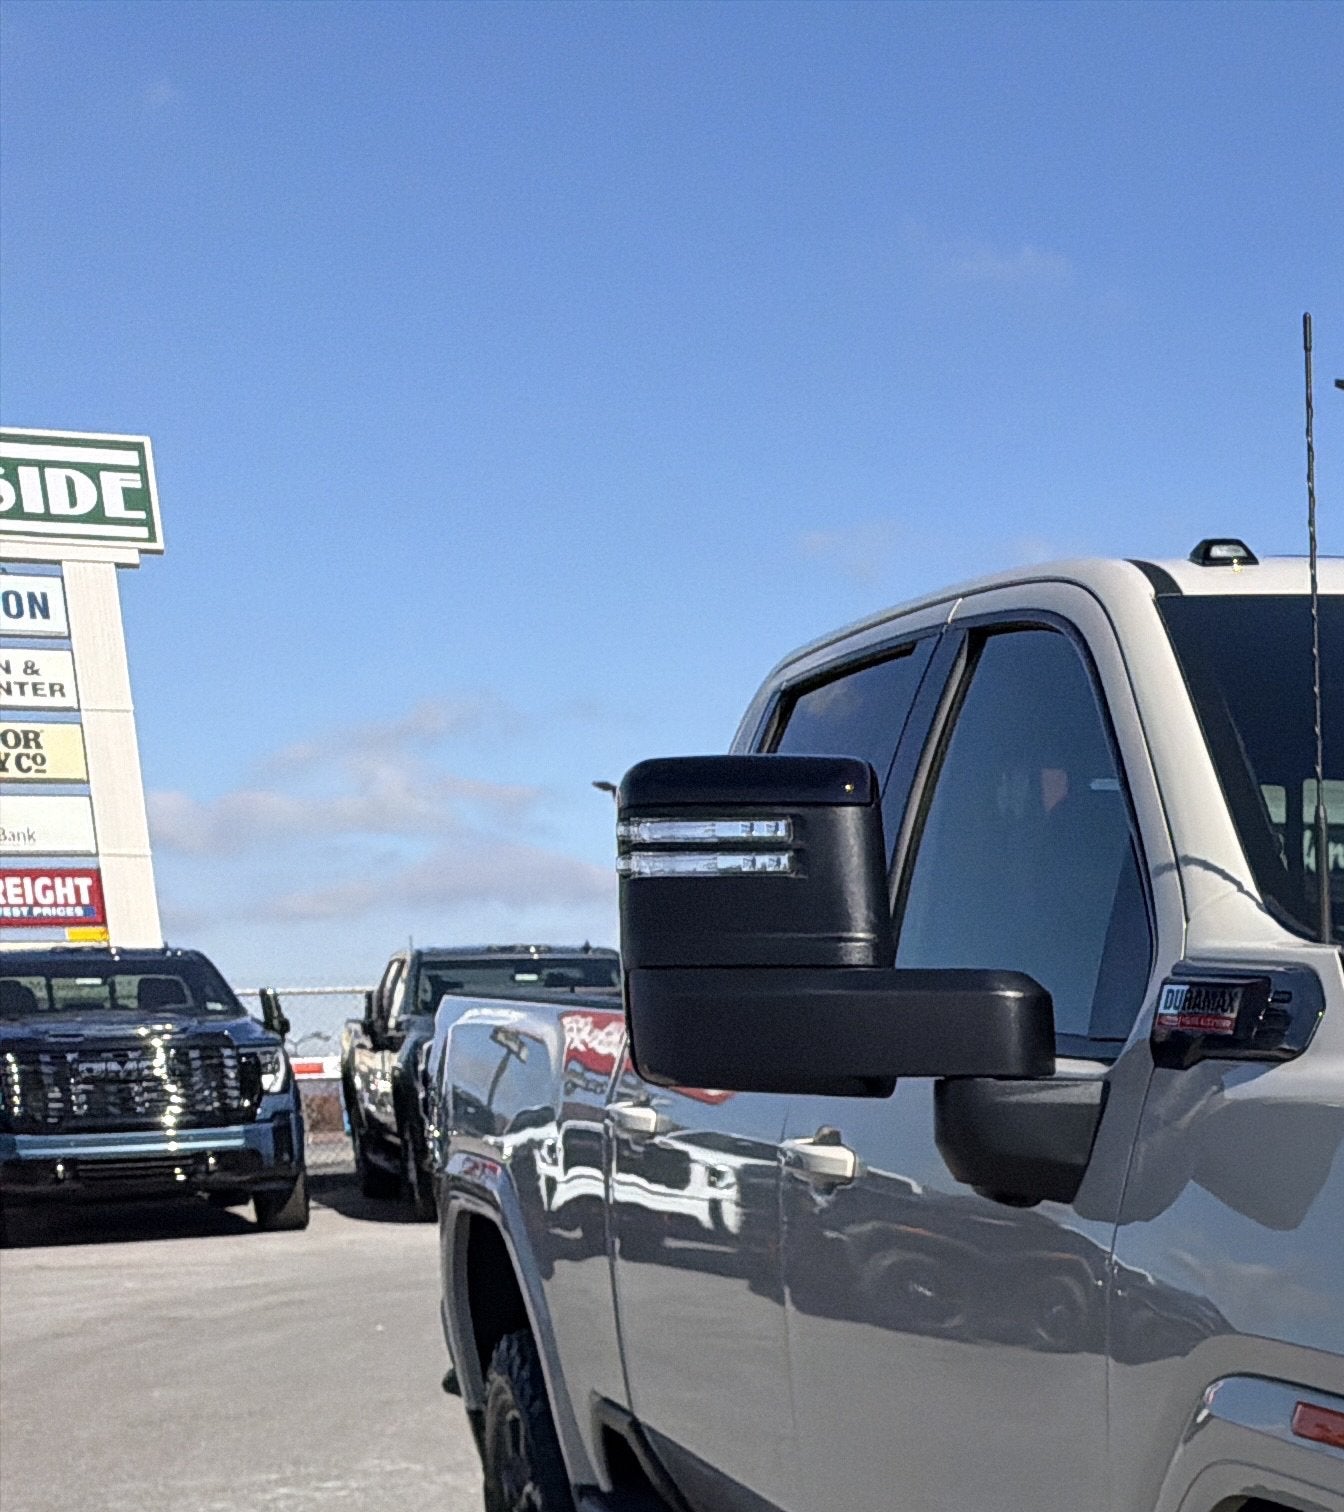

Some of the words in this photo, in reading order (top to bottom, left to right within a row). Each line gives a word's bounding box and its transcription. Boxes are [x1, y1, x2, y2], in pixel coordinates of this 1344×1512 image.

[2, 590, 51, 619] ON
[22, 660, 41, 676] &
[0, 906, 29, 917] EST
[32, 906, 84, 917] PRICES
[1163, 987, 1236, 1014] DURAMAX
